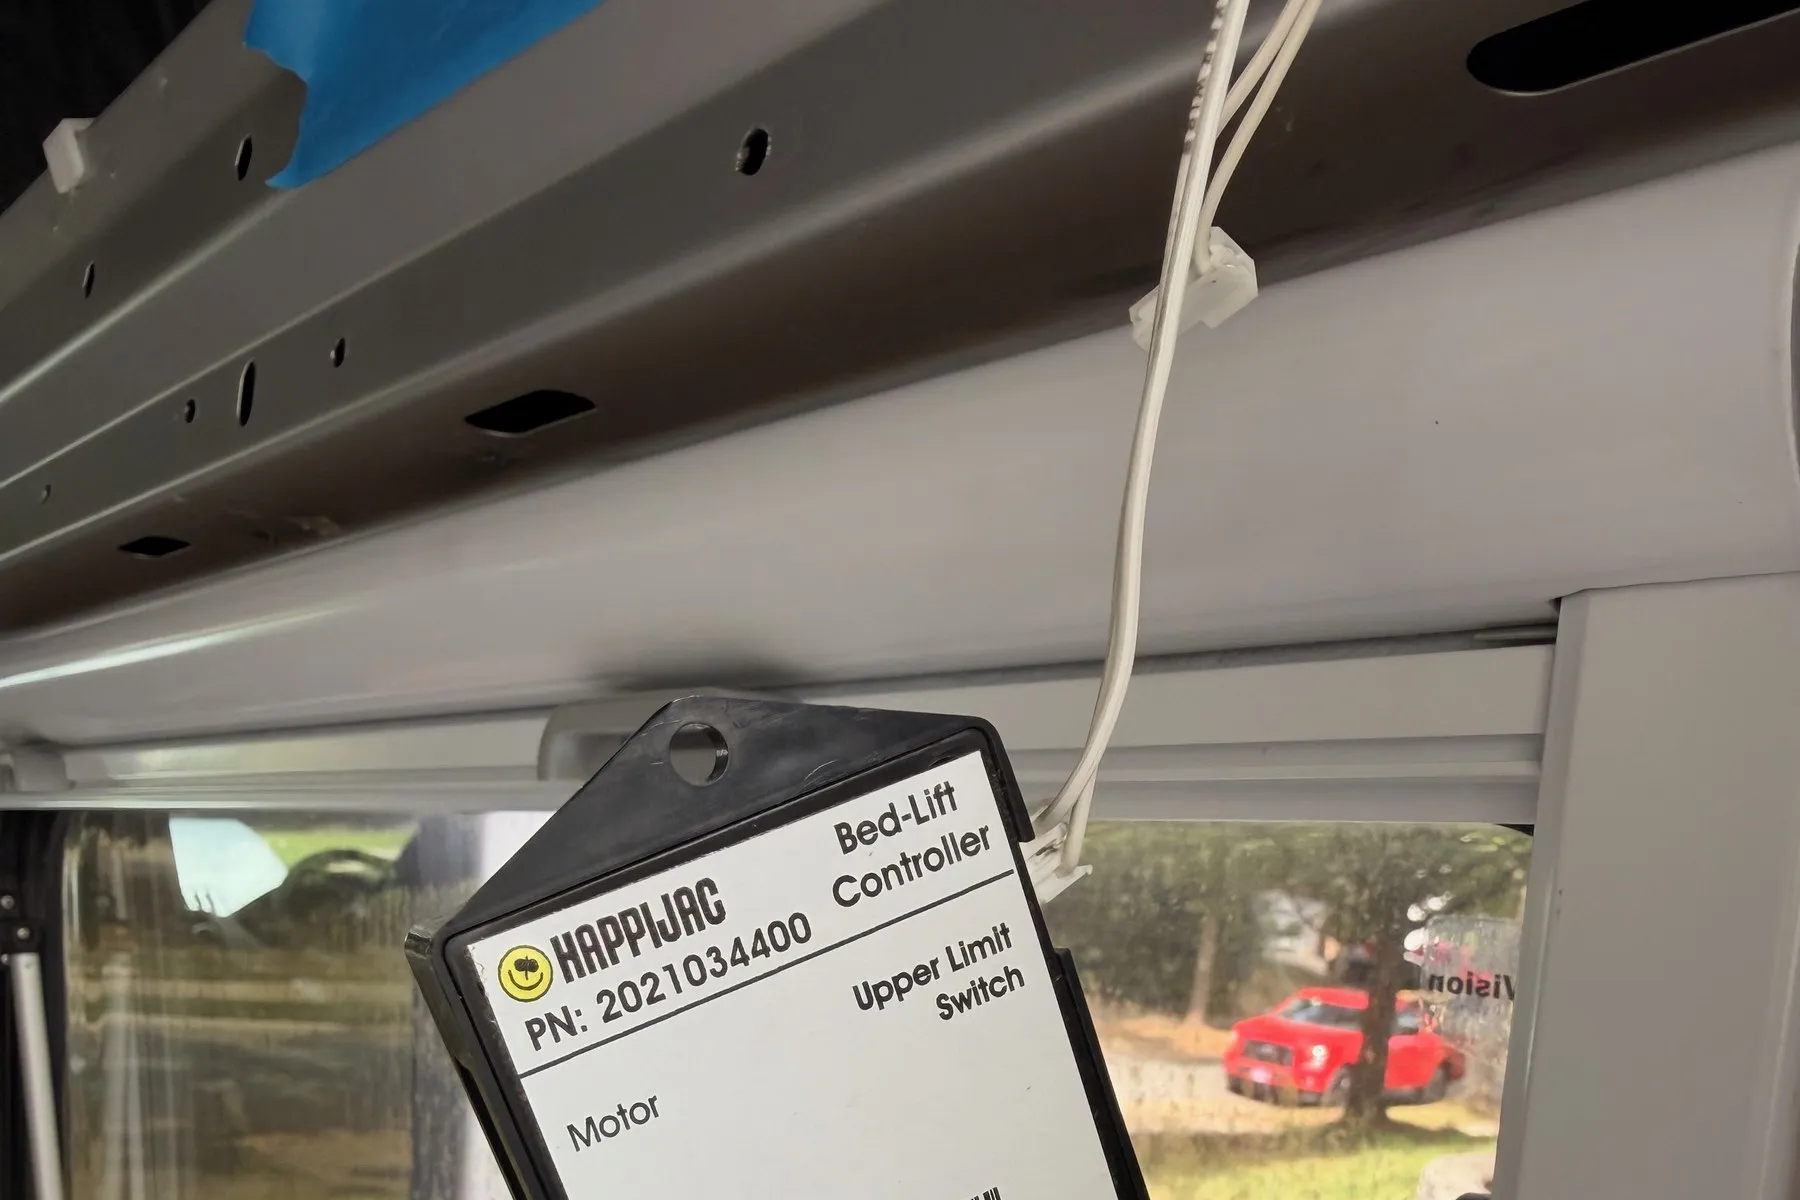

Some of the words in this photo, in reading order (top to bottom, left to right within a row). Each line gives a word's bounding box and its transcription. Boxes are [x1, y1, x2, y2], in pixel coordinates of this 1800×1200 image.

[833, 780, 958, 855] Bed-Lift
[832, 825, 990, 908] Controller
[549, 877, 727, 984] HAPPIJAC
[852, 958, 941, 1011] Upper
[945, 922, 1012, 973] Limit
[524, 1005, 588, 1052] PN:
[596, 912, 812, 1024] 2021034400
[935, 965, 1025, 1021] Switch
[566, 1095, 659, 1152] Motor
